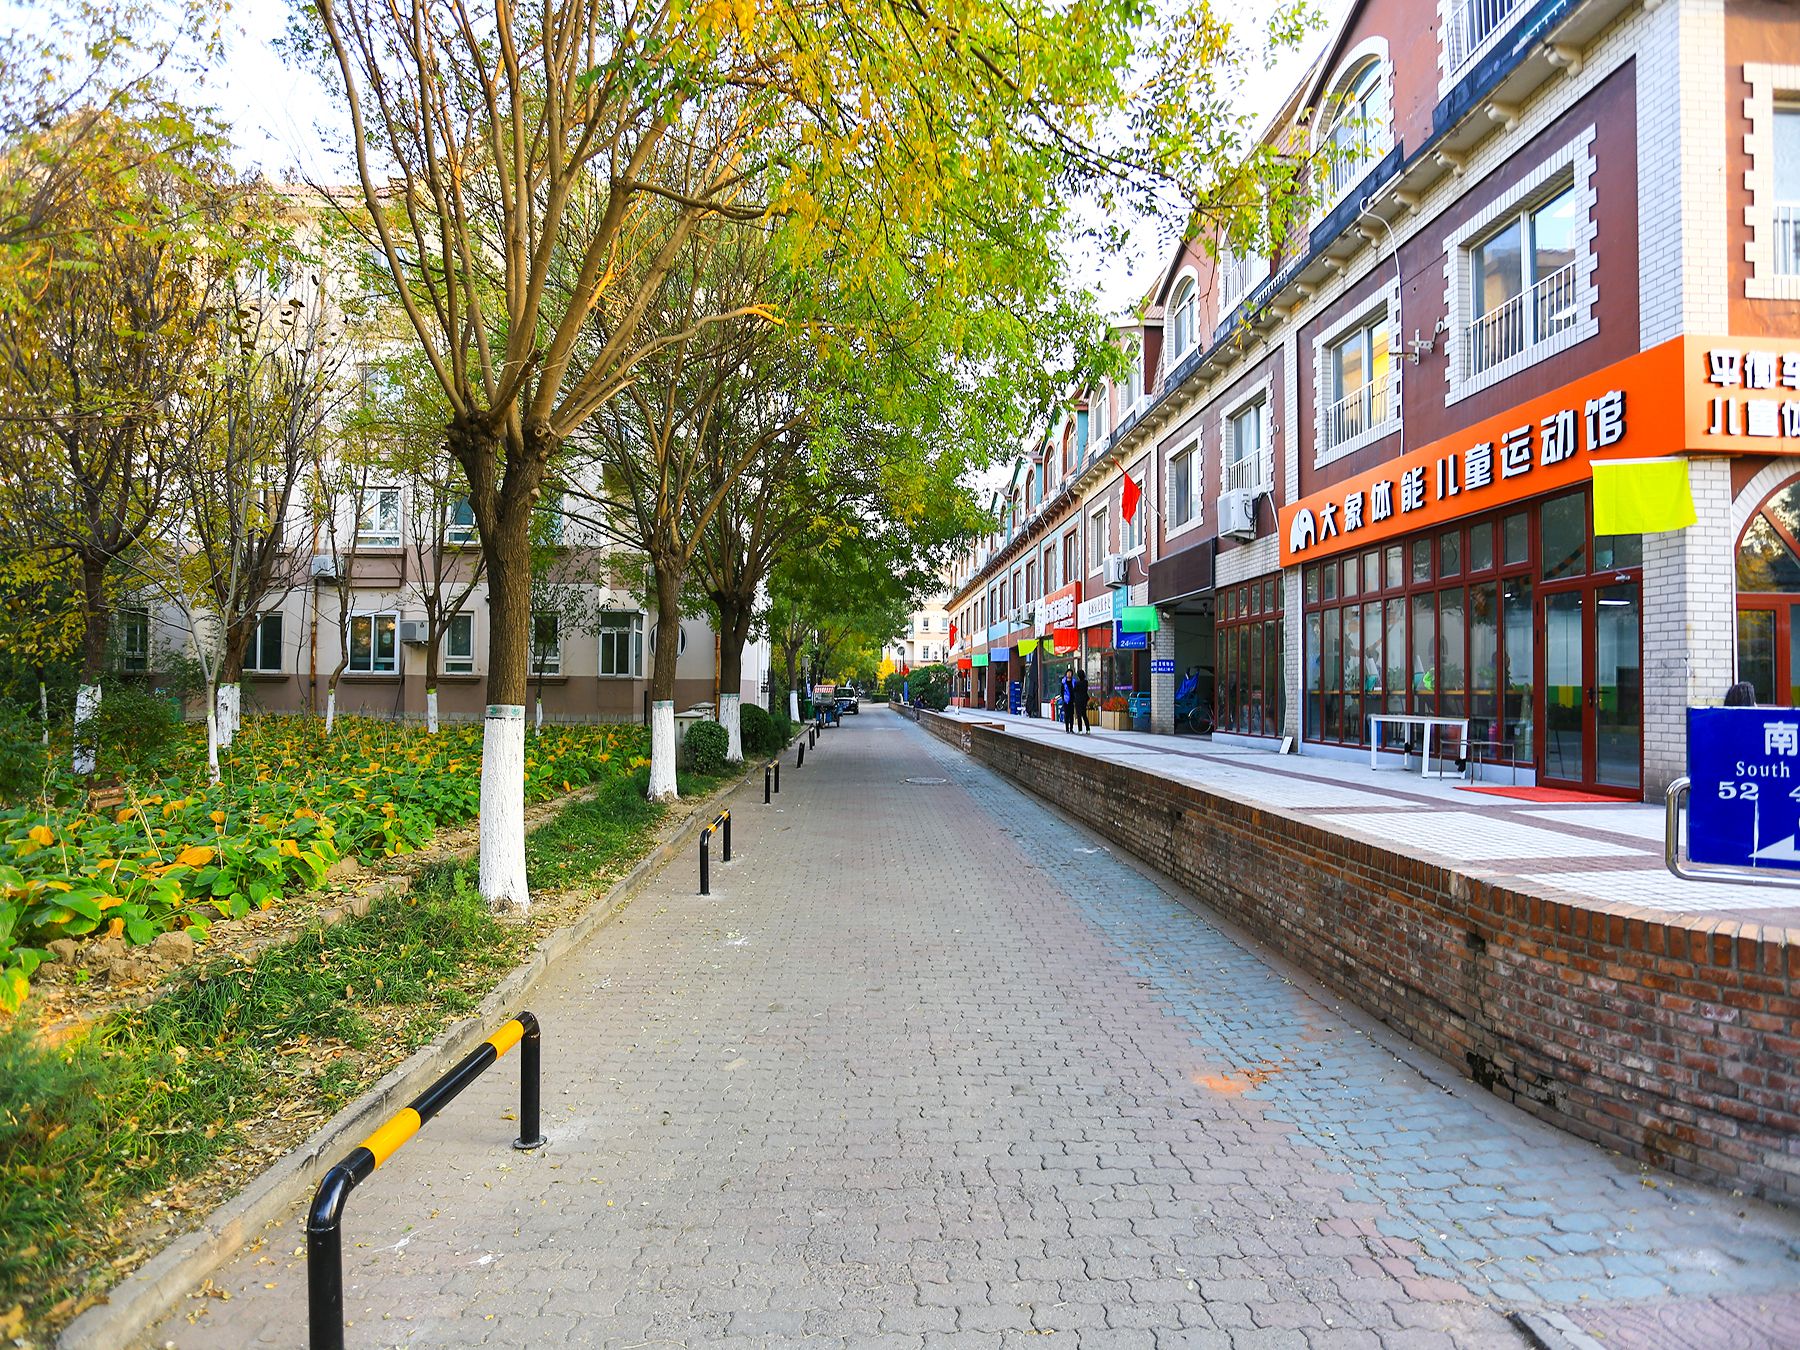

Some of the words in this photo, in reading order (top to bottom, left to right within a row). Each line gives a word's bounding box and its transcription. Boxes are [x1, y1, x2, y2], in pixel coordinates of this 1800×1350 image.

[1319, 390, 1625, 542] 大象体能儿童运动馆
[1763, 720, 1799, 756] 南
[1736, 760, 1791, 778] South
[1718, 781, 1759, 801] 52
